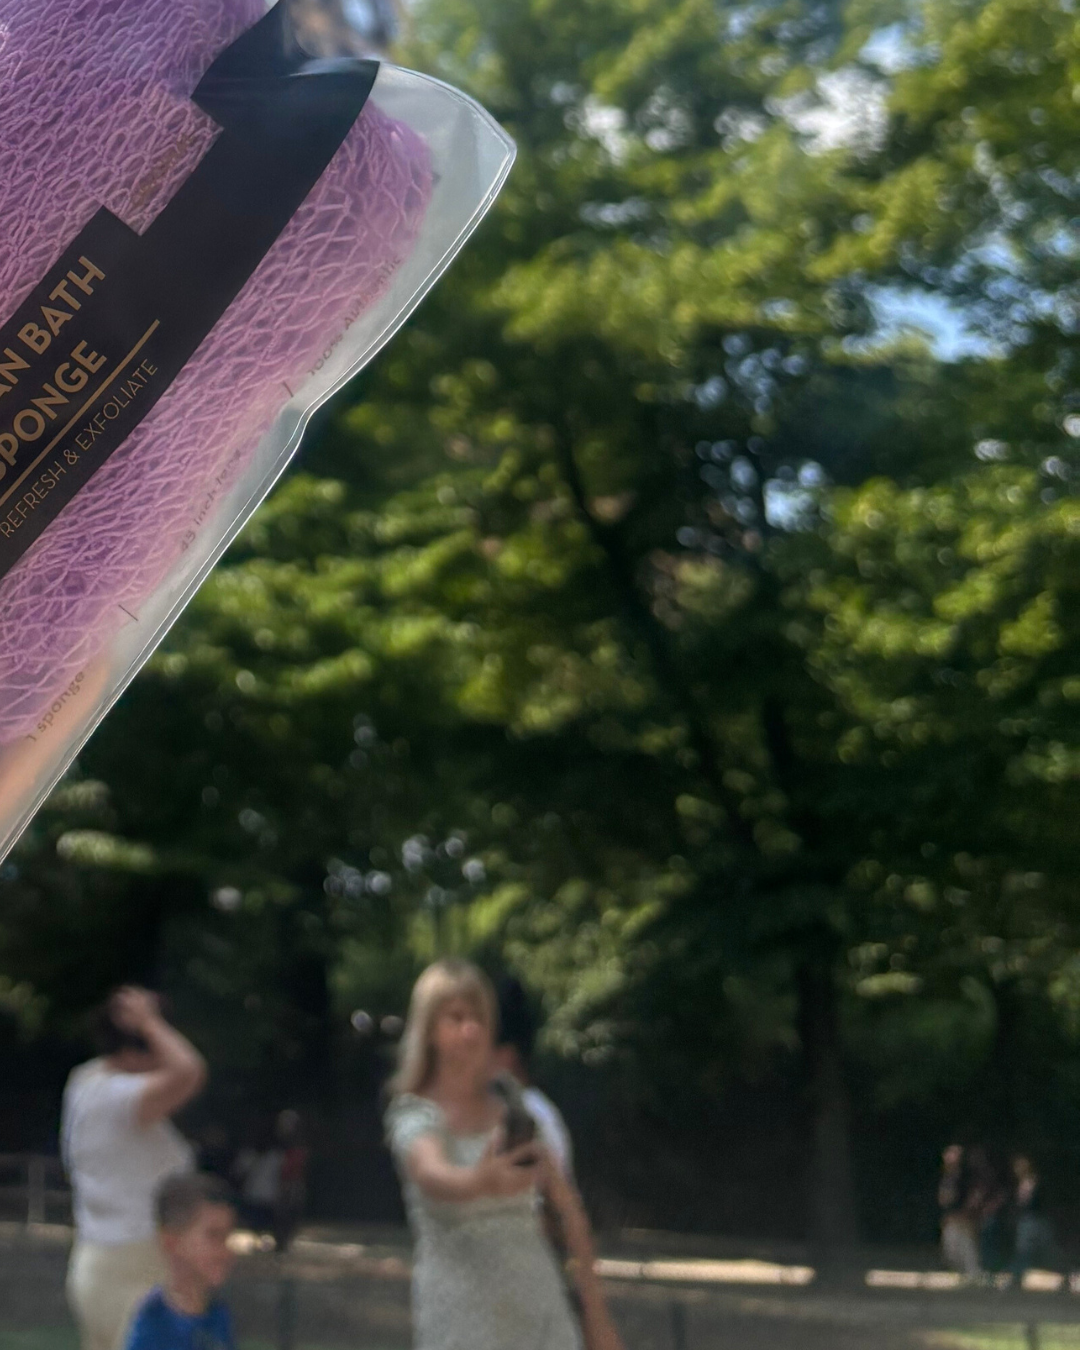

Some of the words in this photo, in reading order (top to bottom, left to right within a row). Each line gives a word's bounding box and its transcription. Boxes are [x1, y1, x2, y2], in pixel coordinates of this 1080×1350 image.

[17, 255, 106, 355] BATH
[62, 448, 80, 466] &
[75, 358, 158, 450] EXFOLIATE
[38, 672, 84, 732] sponge
